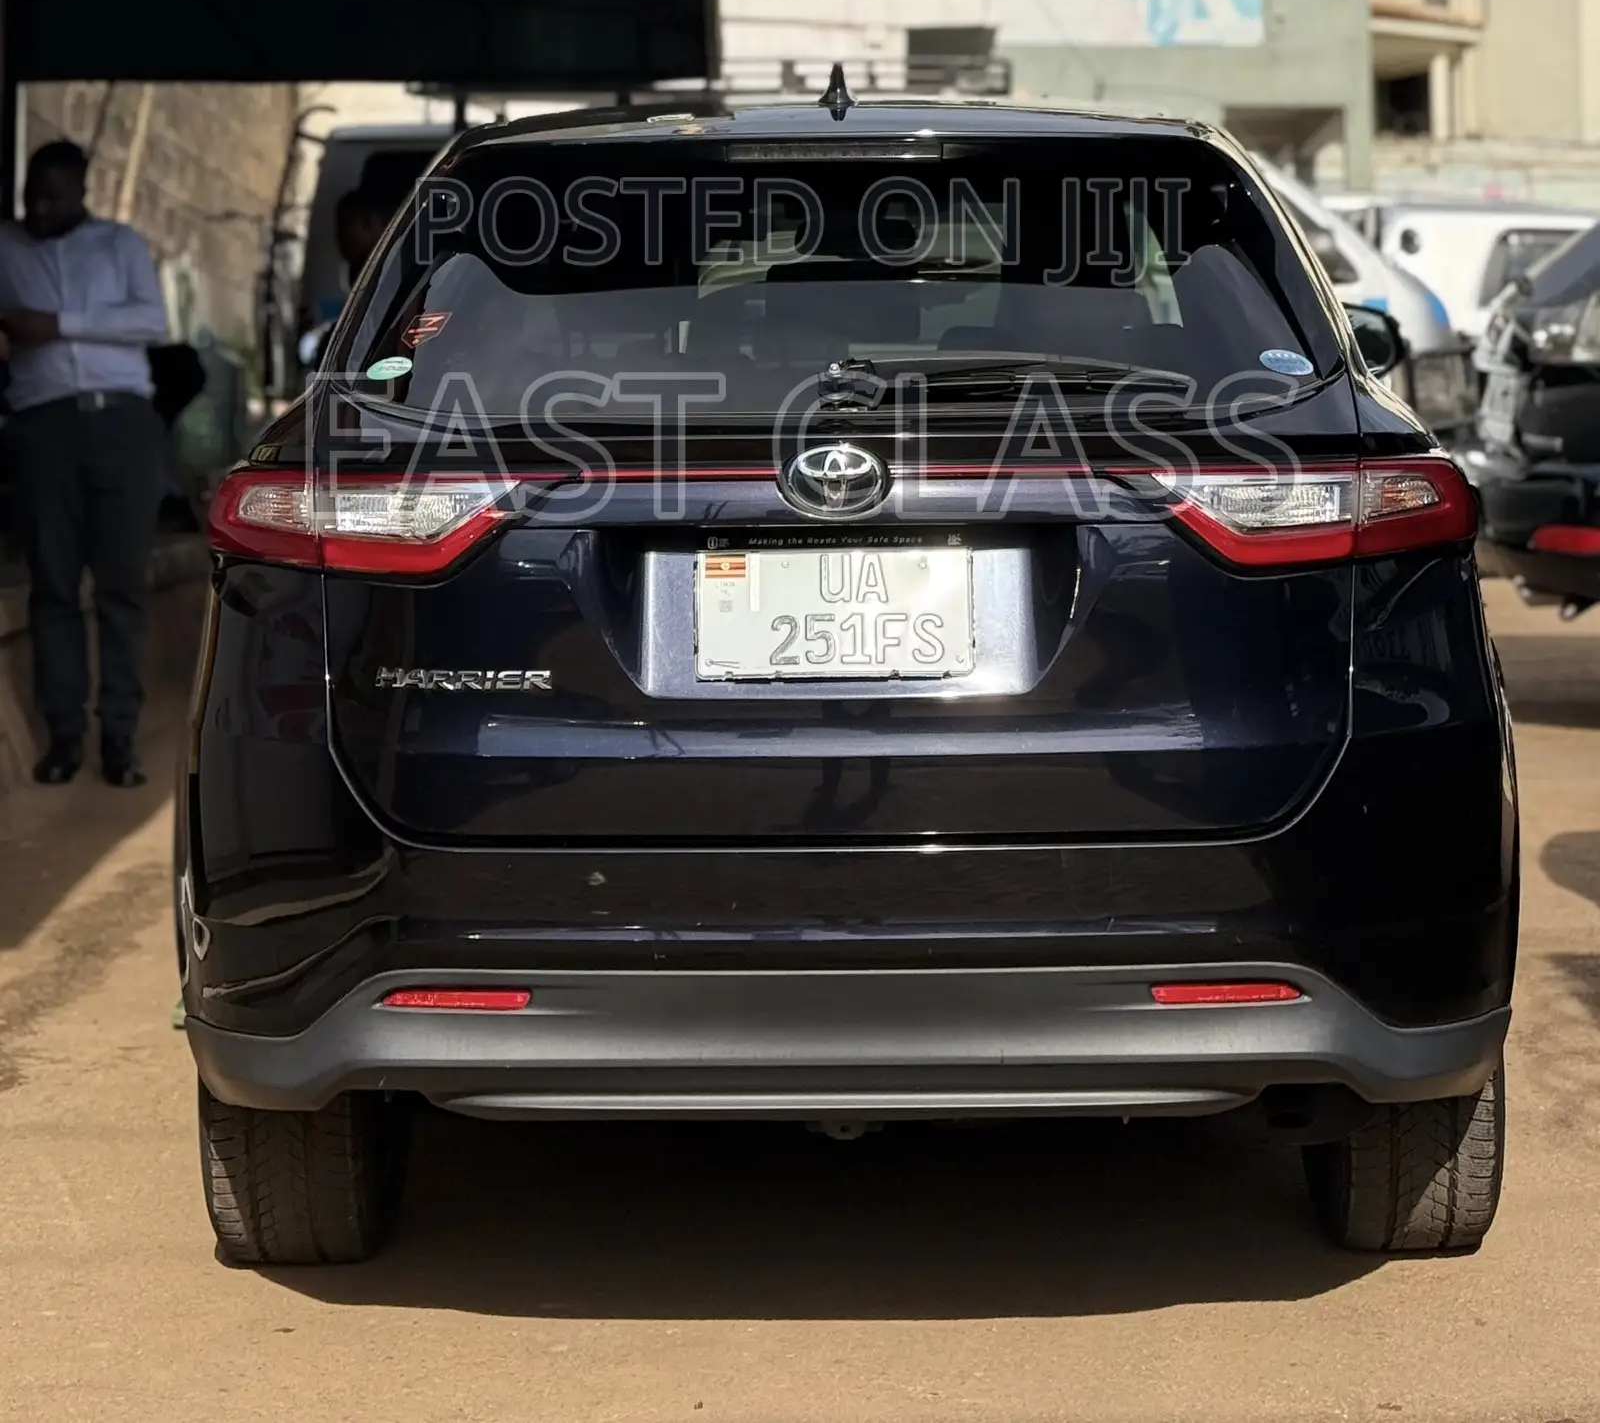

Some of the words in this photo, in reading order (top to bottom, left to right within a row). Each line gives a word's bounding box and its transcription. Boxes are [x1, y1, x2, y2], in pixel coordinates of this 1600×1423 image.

[819, 554, 888, 603] UA
[769, 613, 945, 665] 251FS
[375, 666, 552, 691] HARRIER
